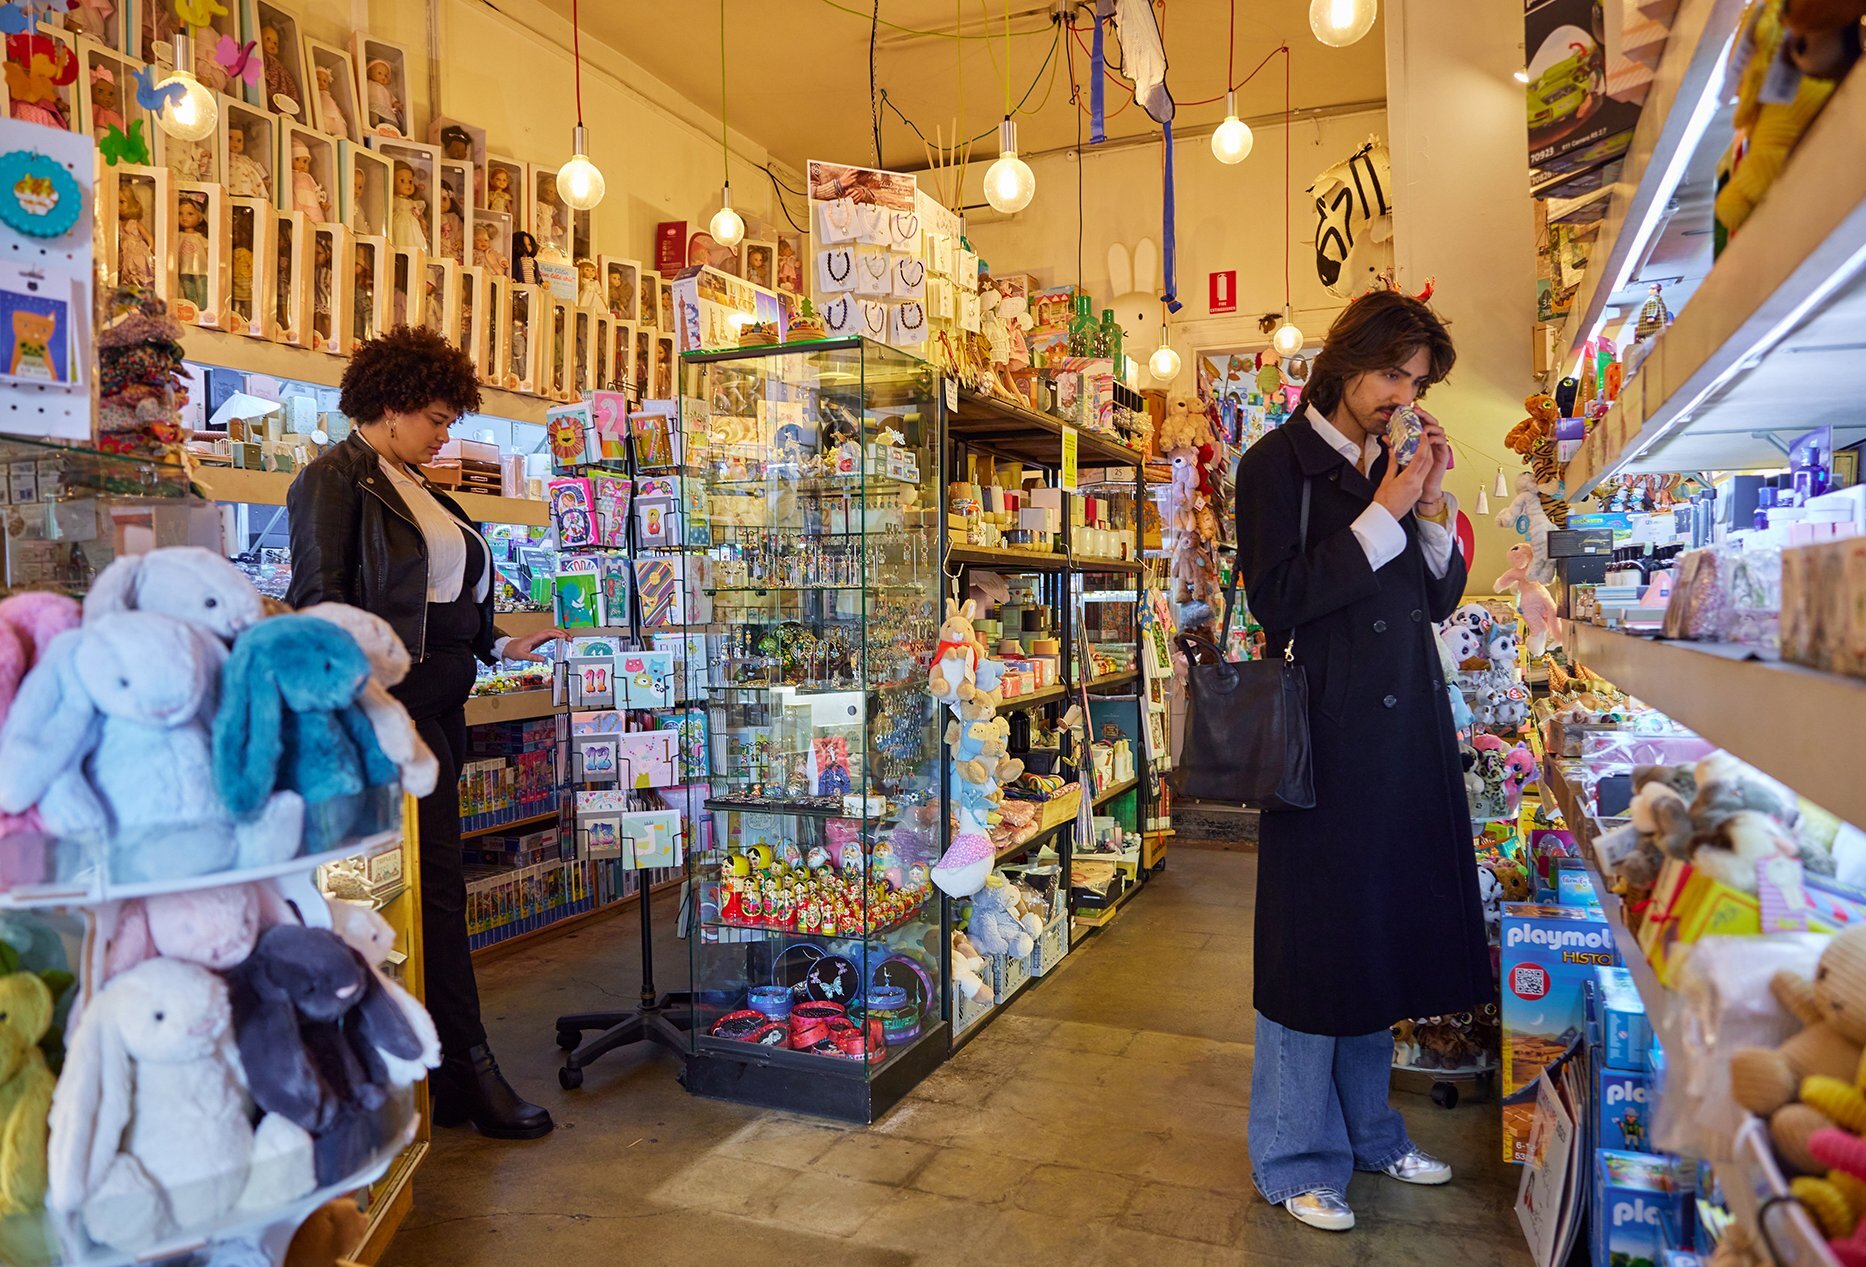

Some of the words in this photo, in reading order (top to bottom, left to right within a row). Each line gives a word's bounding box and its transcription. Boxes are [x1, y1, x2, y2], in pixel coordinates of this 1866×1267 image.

[1530, 146, 1554, 163] 70923
[600, 398, 618, 441] 2
[1114, 468, 1122, 477] 25
[647, 508, 660, 535] 8
[584, 668, 607, 692] 11
[585, 746, 612, 771] 12
[590, 822, 616, 847] 13
